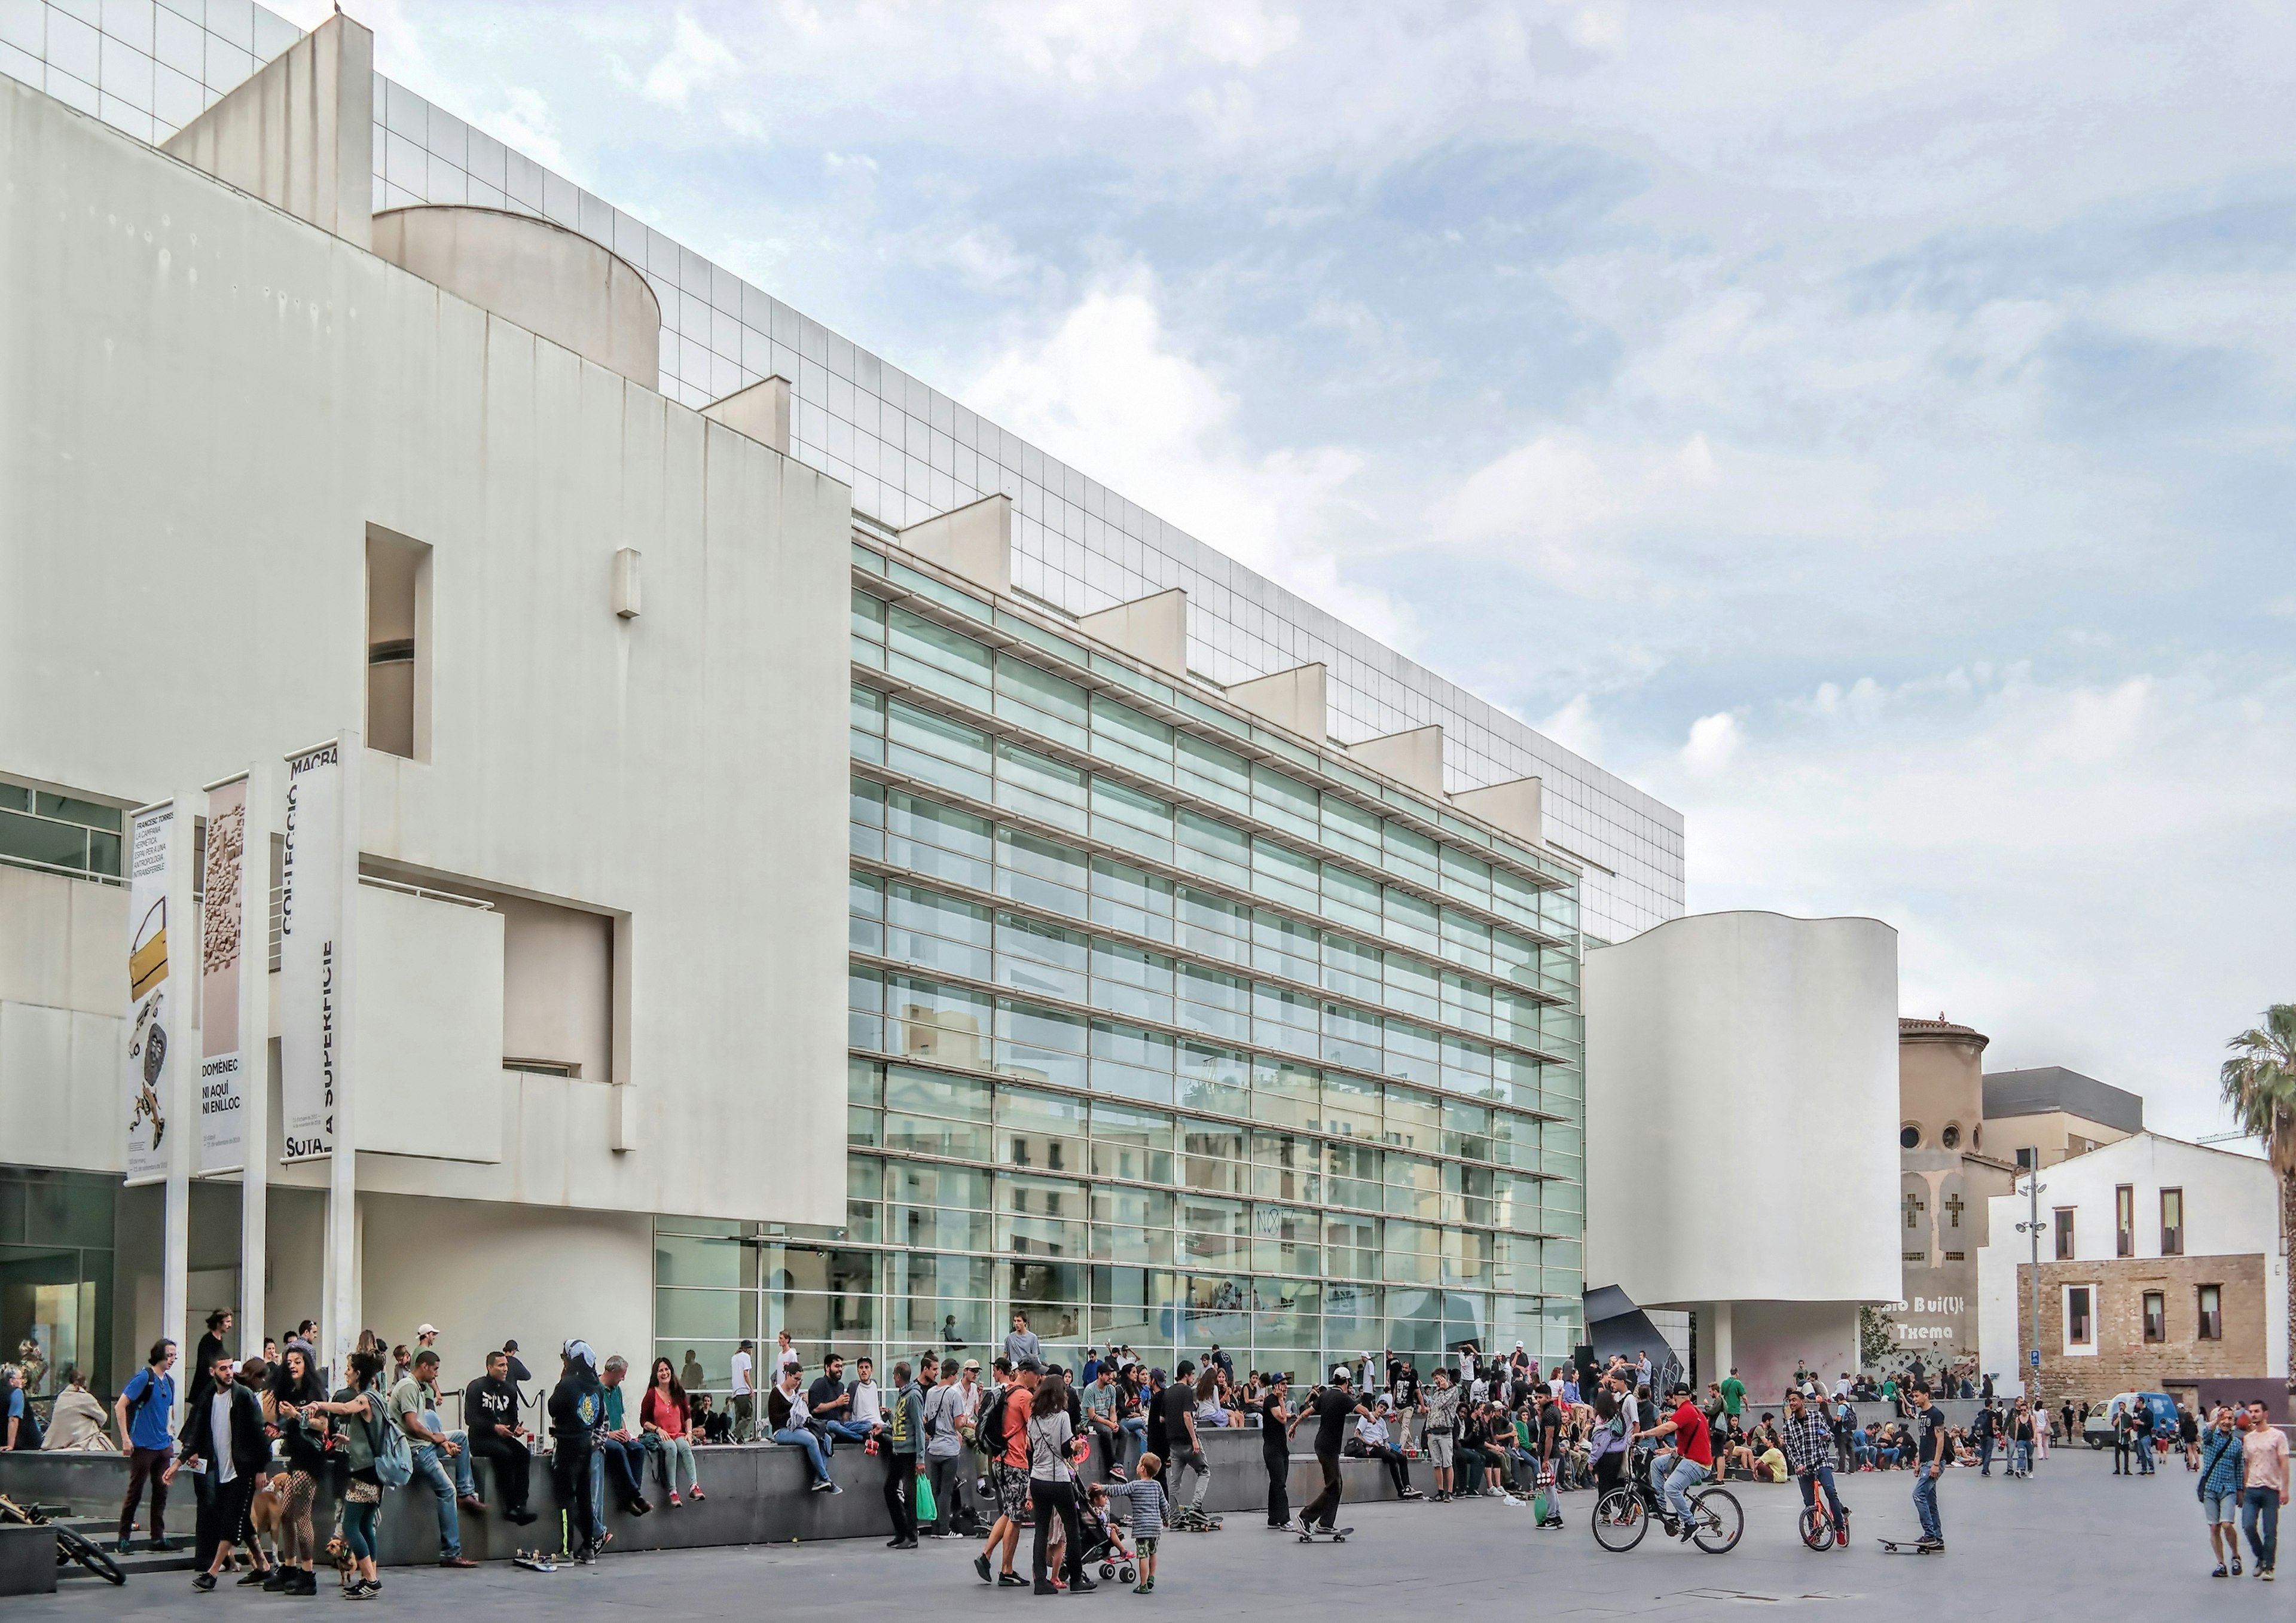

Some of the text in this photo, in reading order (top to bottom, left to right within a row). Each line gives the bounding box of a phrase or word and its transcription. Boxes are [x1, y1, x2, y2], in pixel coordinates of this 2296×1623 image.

[136, 817, 158, 830] FRANCESC
[141, 826, 161, 838] CAMPANA
[202, 1059, 238, 1077] DOMÈNEC
[202, 1080, 228, 1099] NI AQUÍ
[203, 1096, 240, 1114] NI ENLLOC
[1897, 1324, 1953, 1339] Txema
